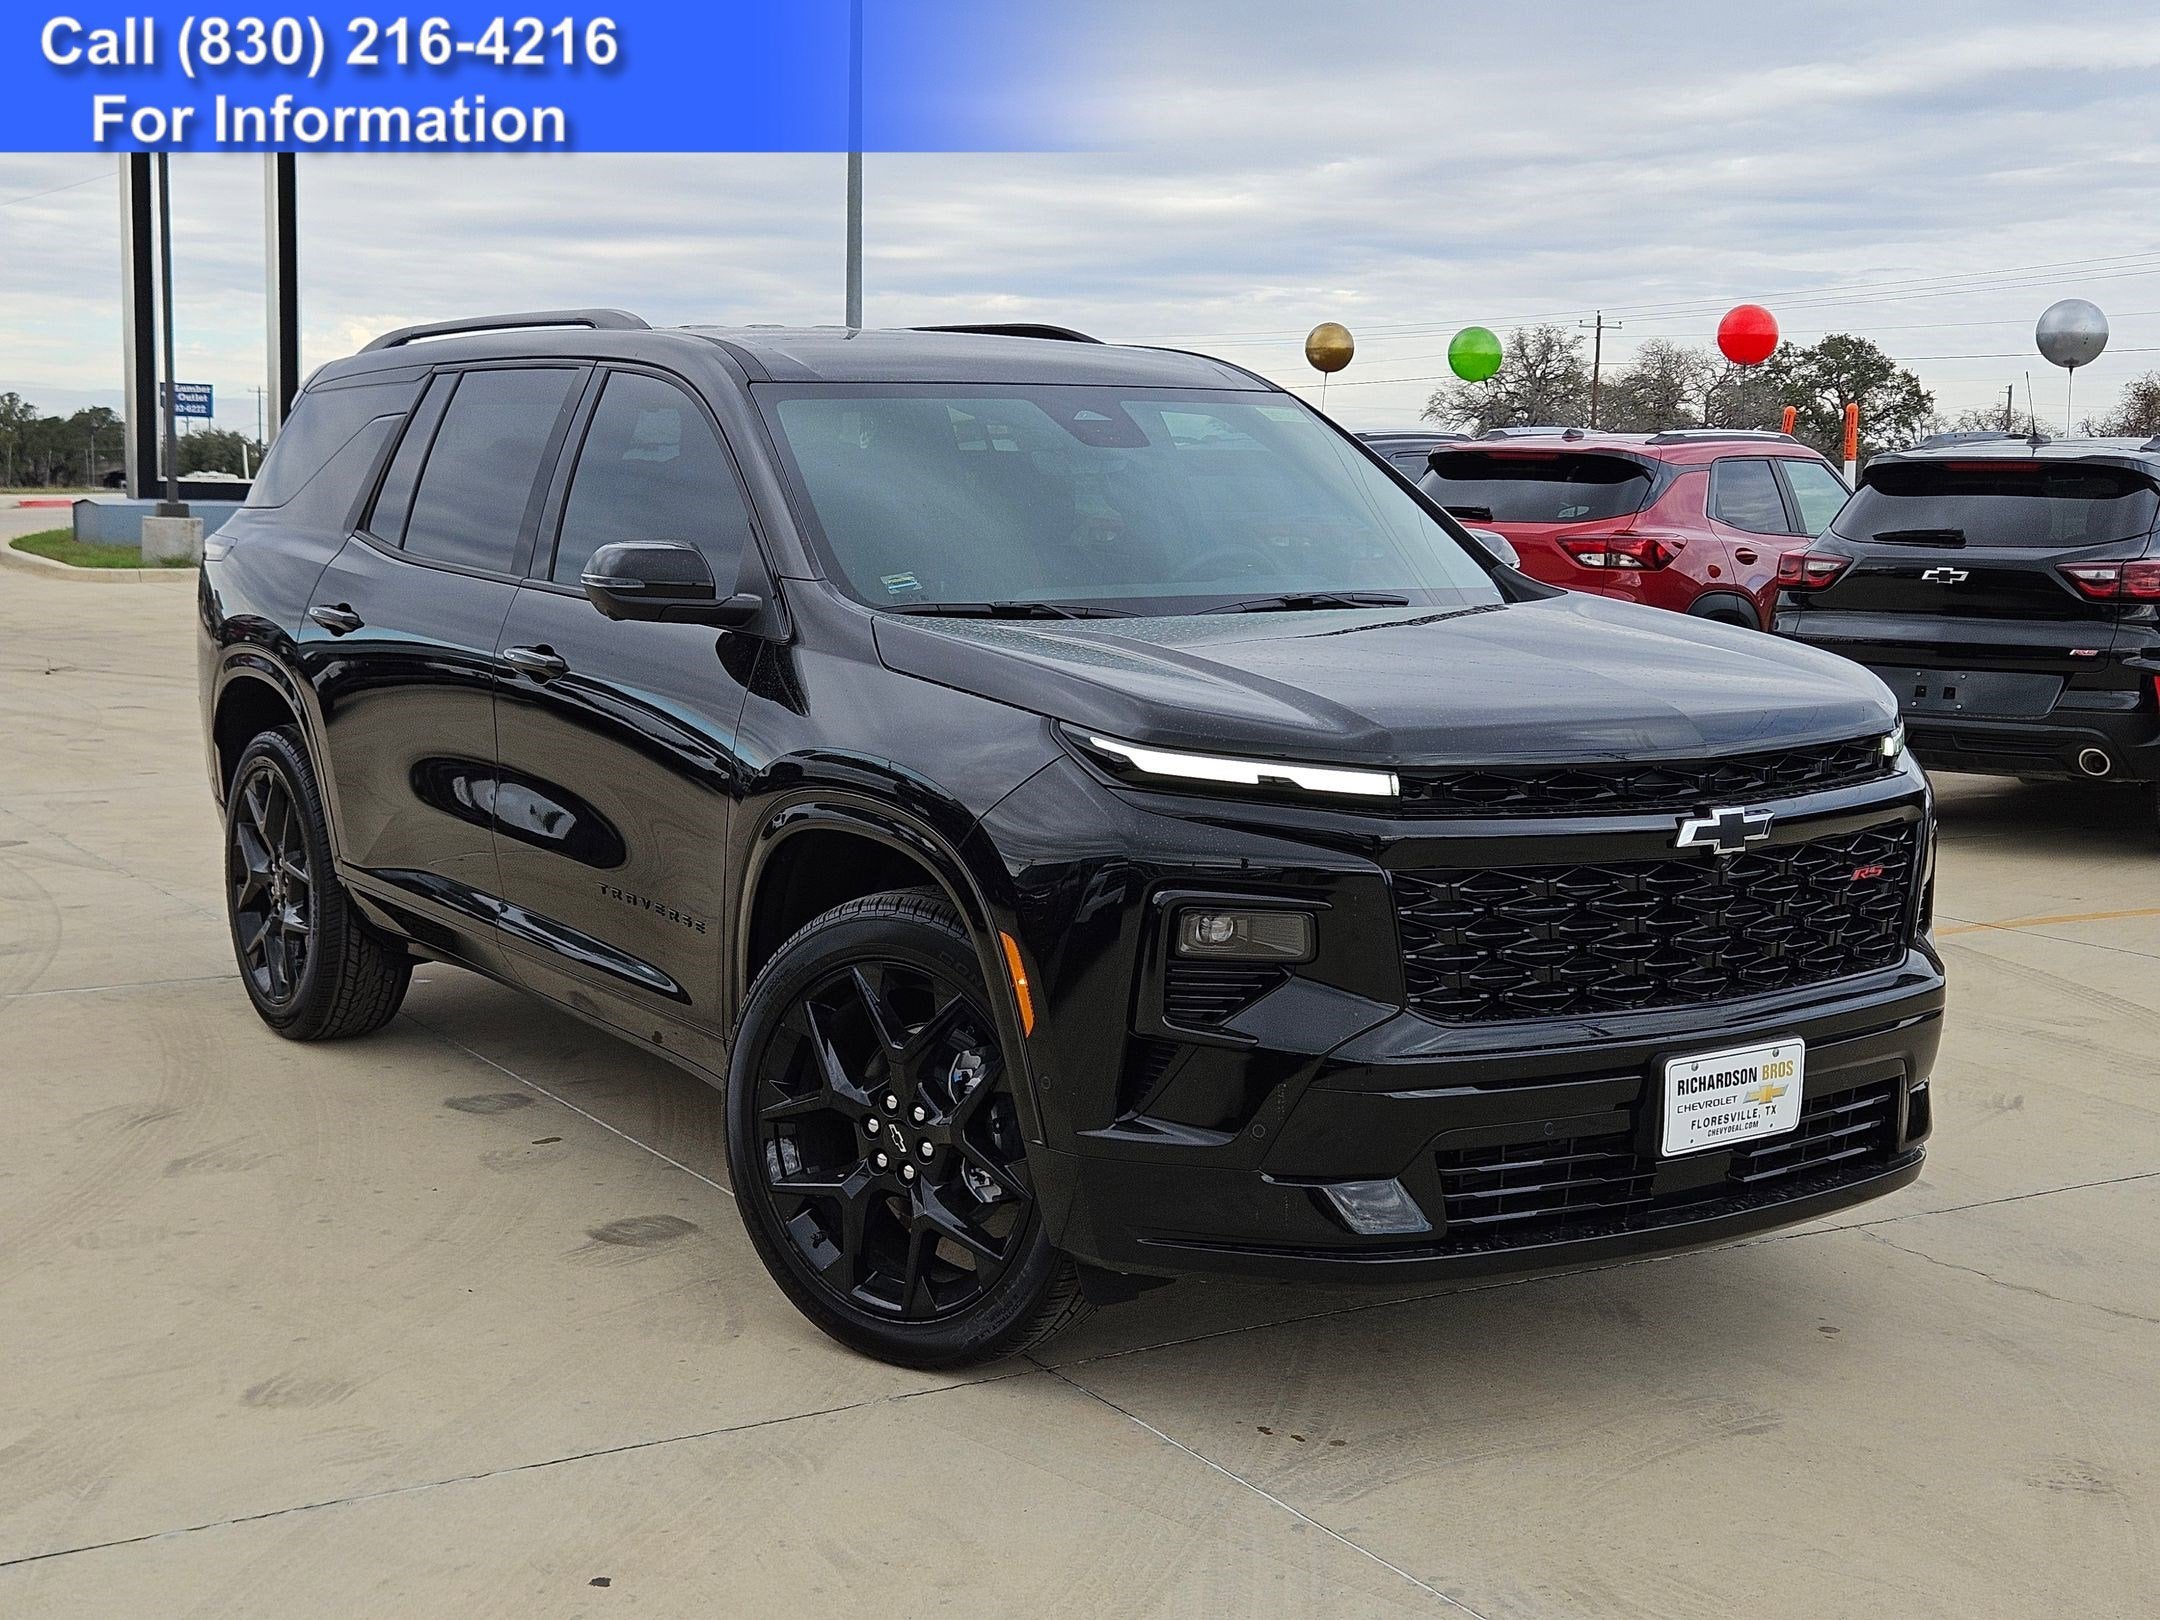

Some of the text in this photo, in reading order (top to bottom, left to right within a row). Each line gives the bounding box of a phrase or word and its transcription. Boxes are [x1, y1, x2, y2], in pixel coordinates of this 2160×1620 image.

[177, 393, 208, 402] Outlet
[1850, 865, 1884, 881] RS
[595, 882, 706, 934] TRAVERSE
[1677, 1060, 1793, 1096] RICHARDSON BROS
[1677, 1095, 1738, 1114] CHEVROLET
[1691, 1105, 1777, 1130] FLORESVILLE, TX
[1707, 1121, 1759, 1137] CHEVYDEAL.COM
